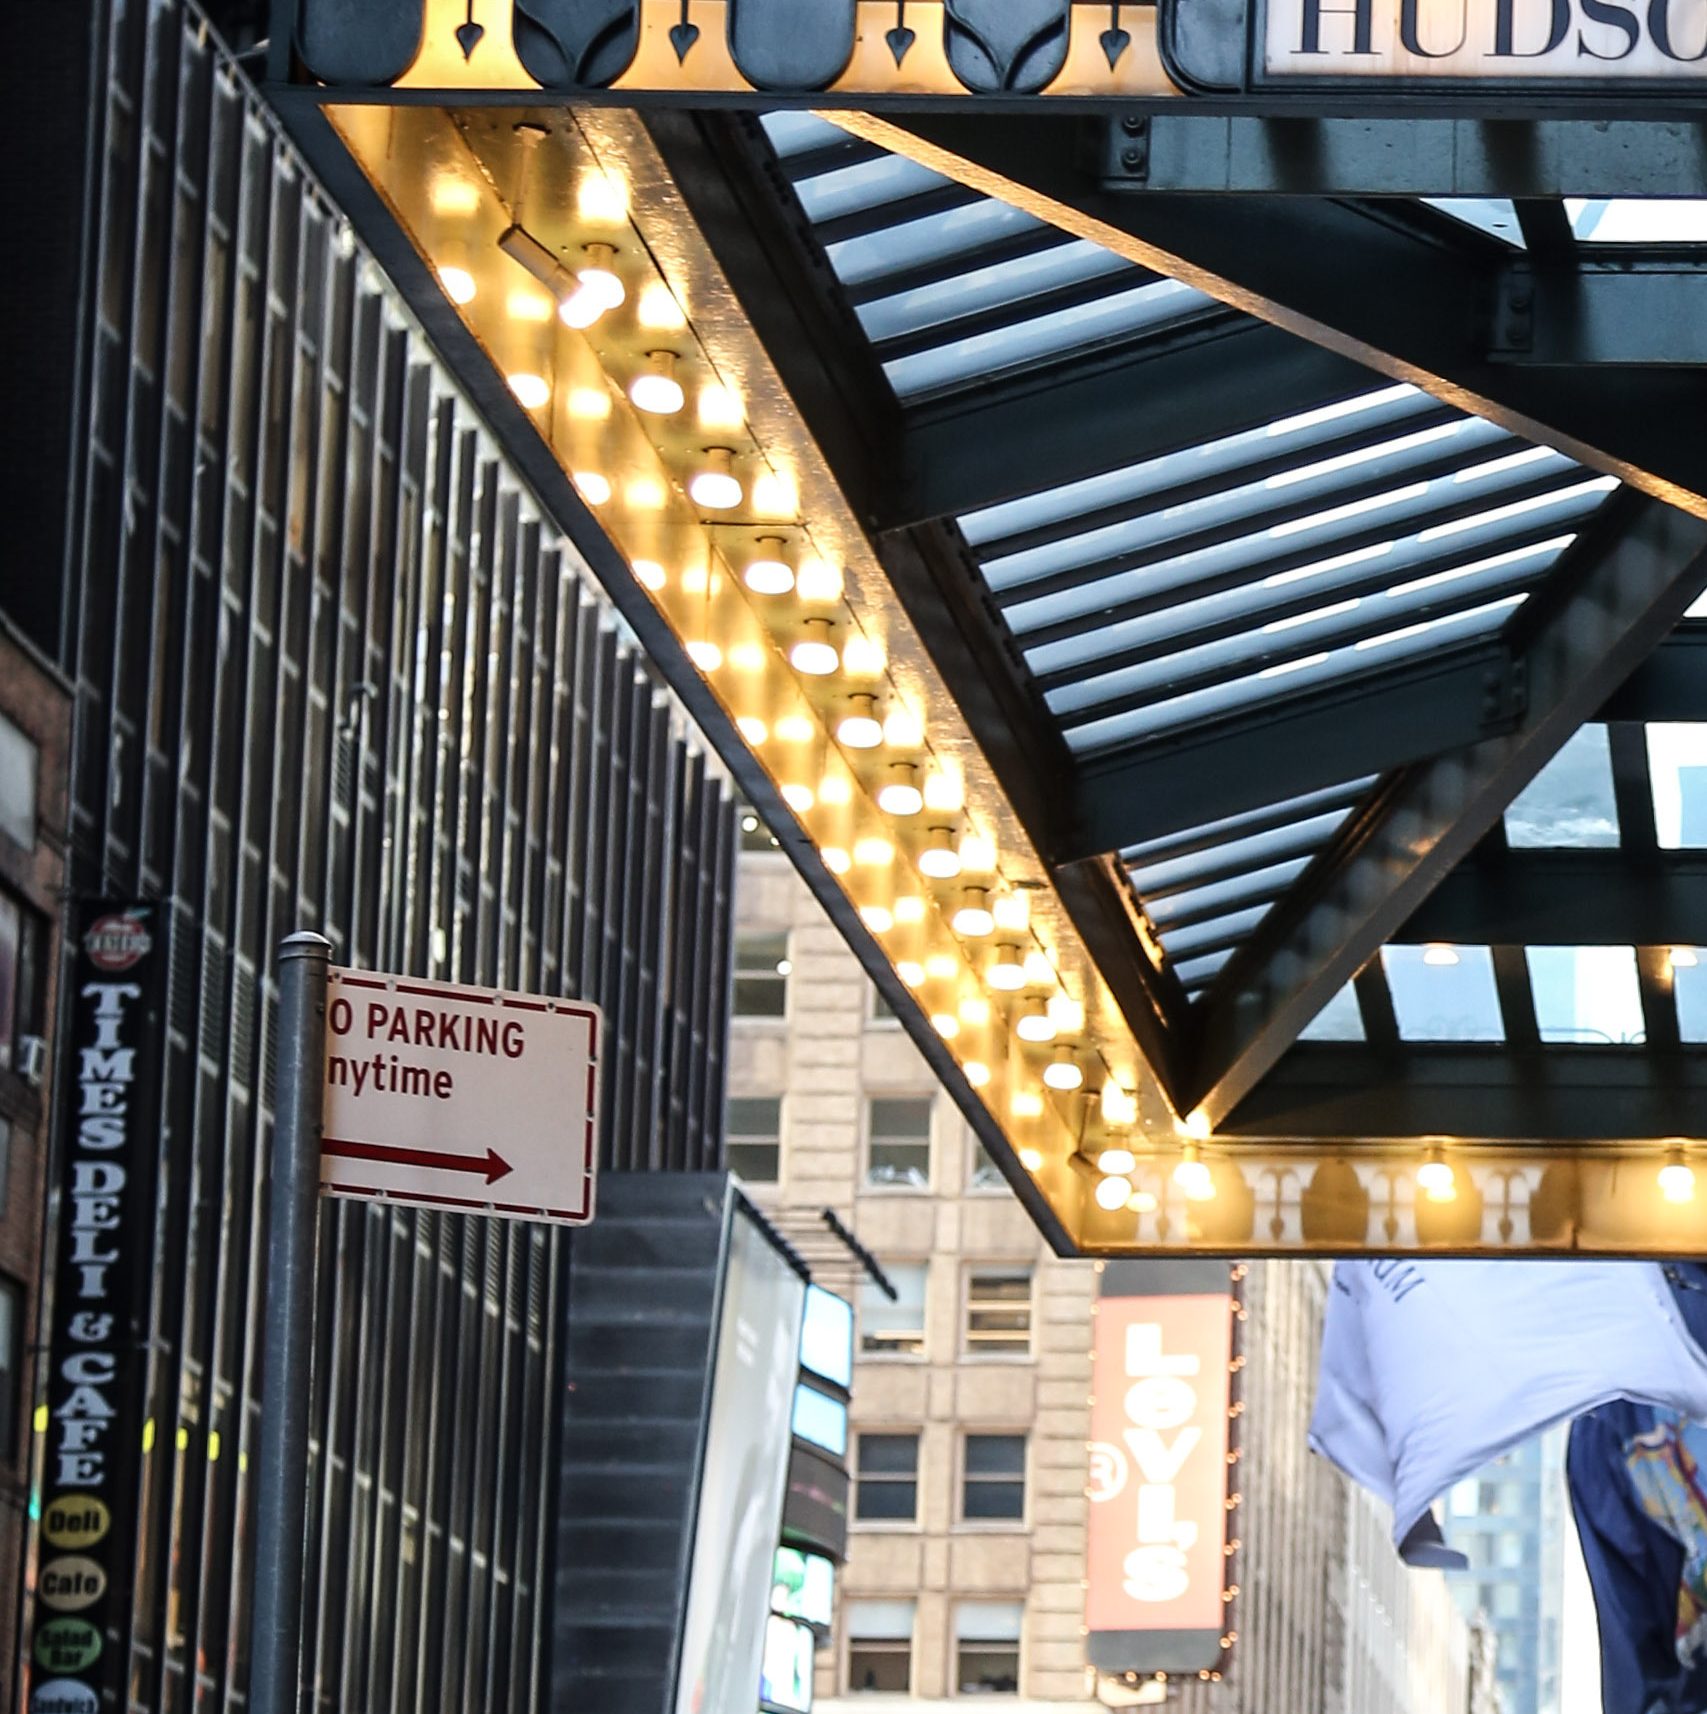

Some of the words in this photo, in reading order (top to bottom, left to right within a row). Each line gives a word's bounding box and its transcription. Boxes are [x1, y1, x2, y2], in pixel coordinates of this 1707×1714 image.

[328, 997, 353, 1036] O
[367, 1002, 525, 1059] PARKING
[78, 982, 142, 1151] TIMES
[328, 1053, 454, 1100] nytime
[70, 1160, 127, 1298] DELI
[67, 1311, 116, 1342] &
[43, 1351, 117, 1486] CAFE
[49, 1510, 101, 1533] Deli
[42, 1571, 99, 1595] Cafe
